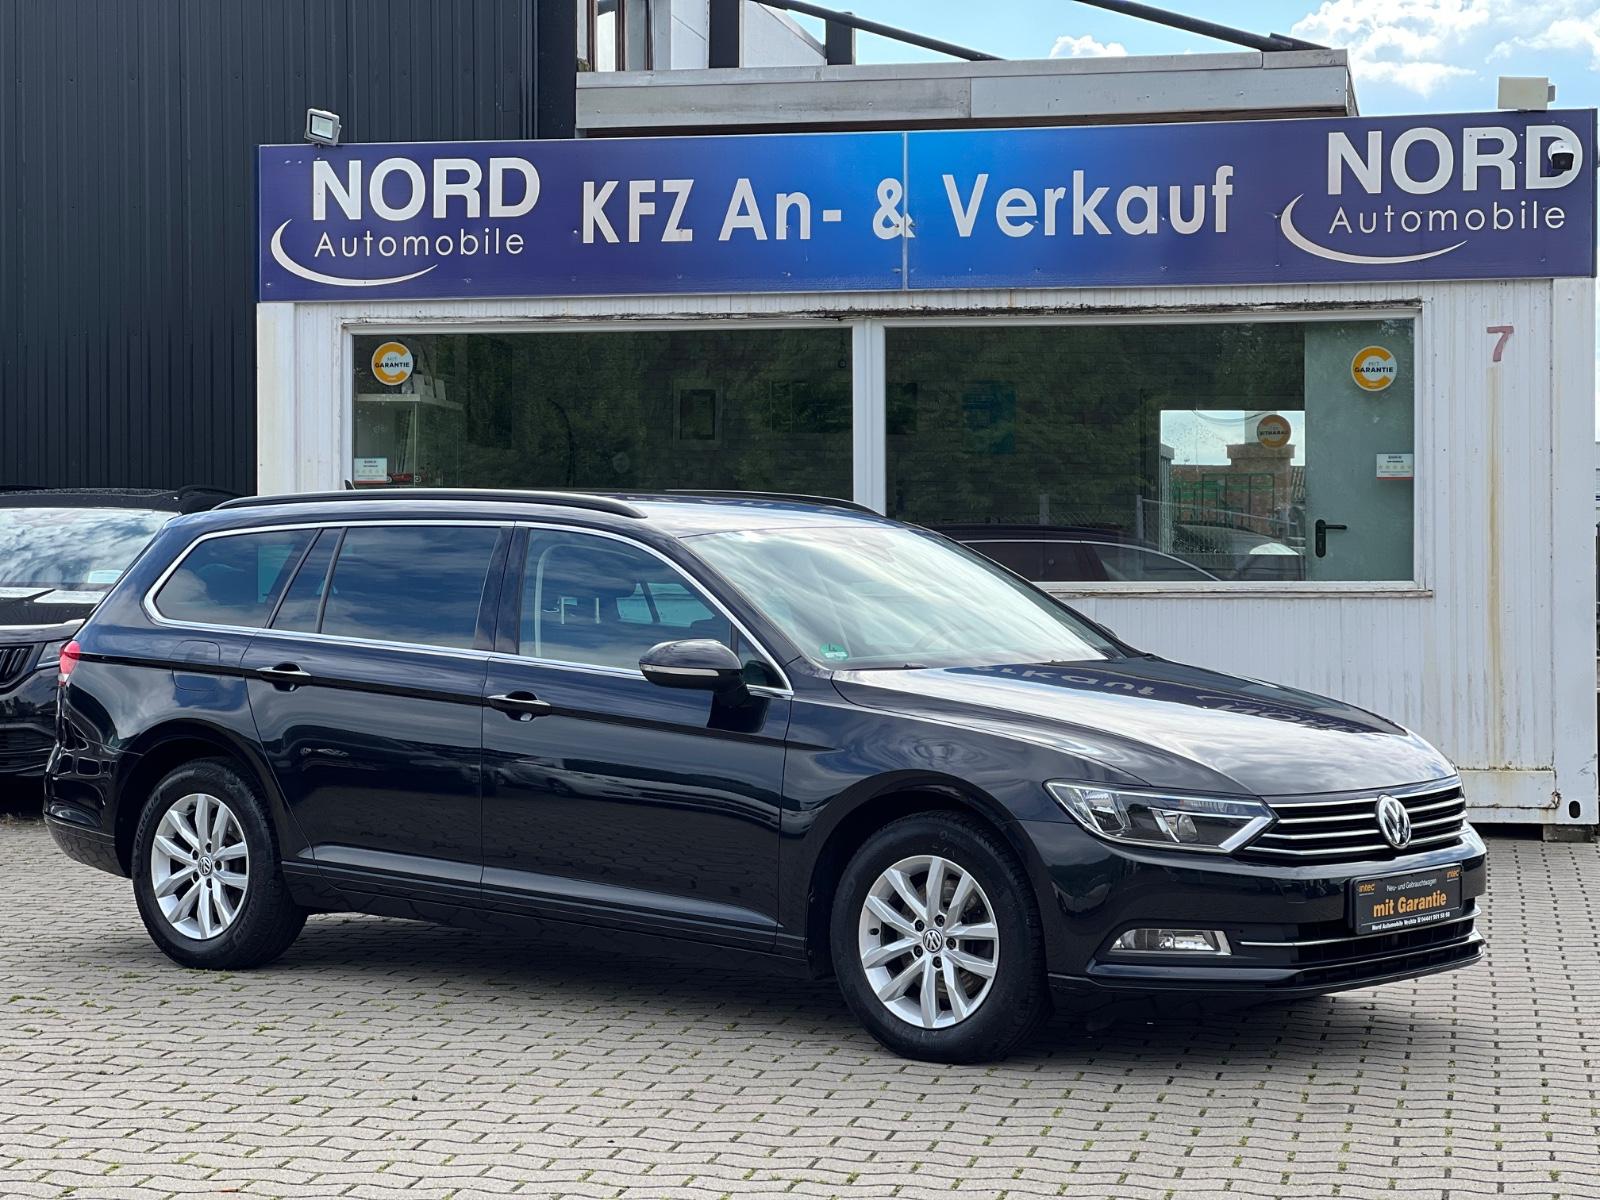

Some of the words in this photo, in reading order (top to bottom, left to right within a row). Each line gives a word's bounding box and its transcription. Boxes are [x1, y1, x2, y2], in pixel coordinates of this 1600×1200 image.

[1328, 125, 1584, 196] NORD
[312, 158, 541, 222] NORD
[583, 180, 695, 245] KFZ
[719, 179, 843, 241] An-
[873, 178, 915, 241] &
[943, 166, 1235, 239] Verkauf
[1330, 201, 1566, 236] Automobile
[315, 229, 525, 259] Automobile
[1487, 326, 1514, 362] 7
[1373, 899, 1395, 918] mit
[1397, 889, 1447, 913] Garantie
